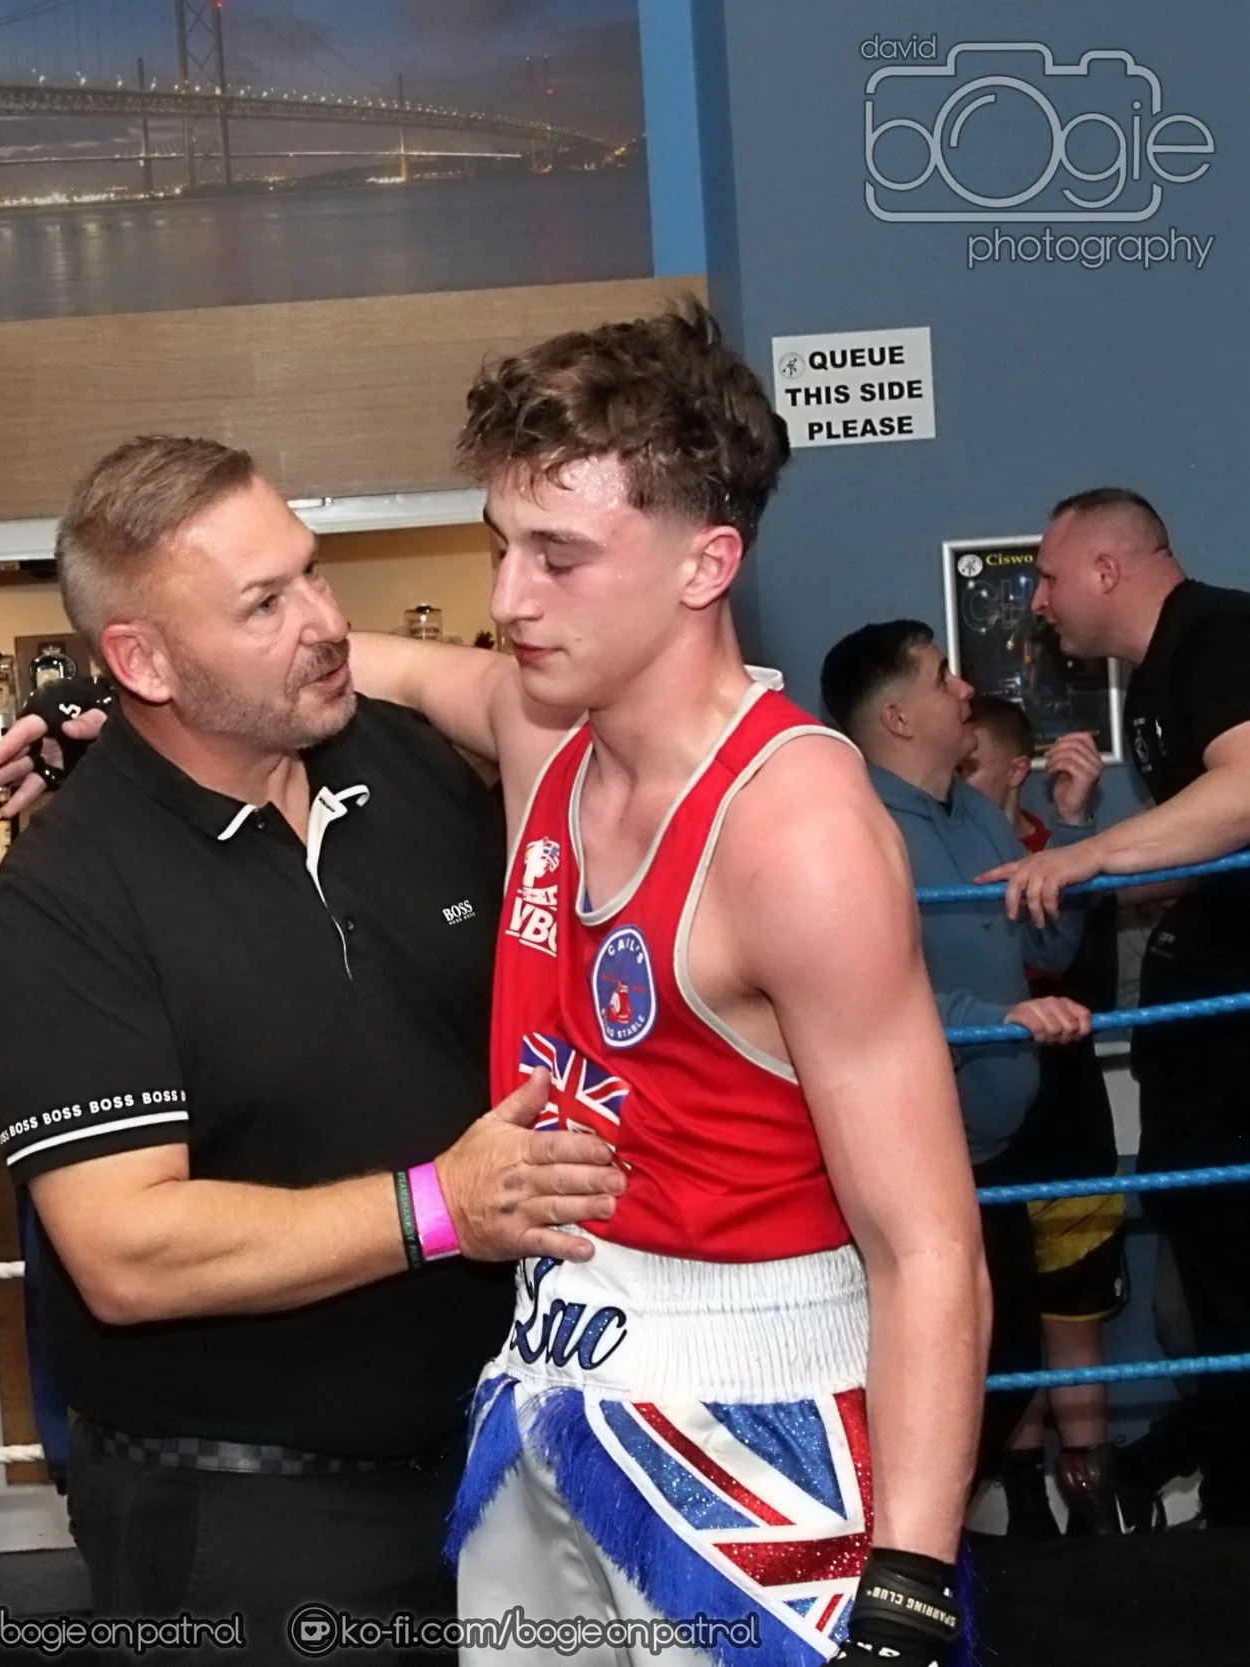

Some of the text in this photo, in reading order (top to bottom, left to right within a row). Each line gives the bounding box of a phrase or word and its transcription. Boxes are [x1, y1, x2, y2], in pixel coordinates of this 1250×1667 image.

[808, 346, 905, 370] QUEUE
[785, 379, 923, 407] THIS SIDE
[808, 415, 913, 440] PLEASE
[985, 553, 1034, 566] Ciswo
[442, 899, 474, 922] BOSS
[616, 1014, 646, 1039] STABLE
[9, 1116, 39, 1137] BOSS
[41, 1104, 83, 1125] BOSS
[88, 1094, 135, 1114] BOSS
[141, 1089, 178, 1105] BOSS
[871, 1586, 958, 1628] SPARRING CLUB
